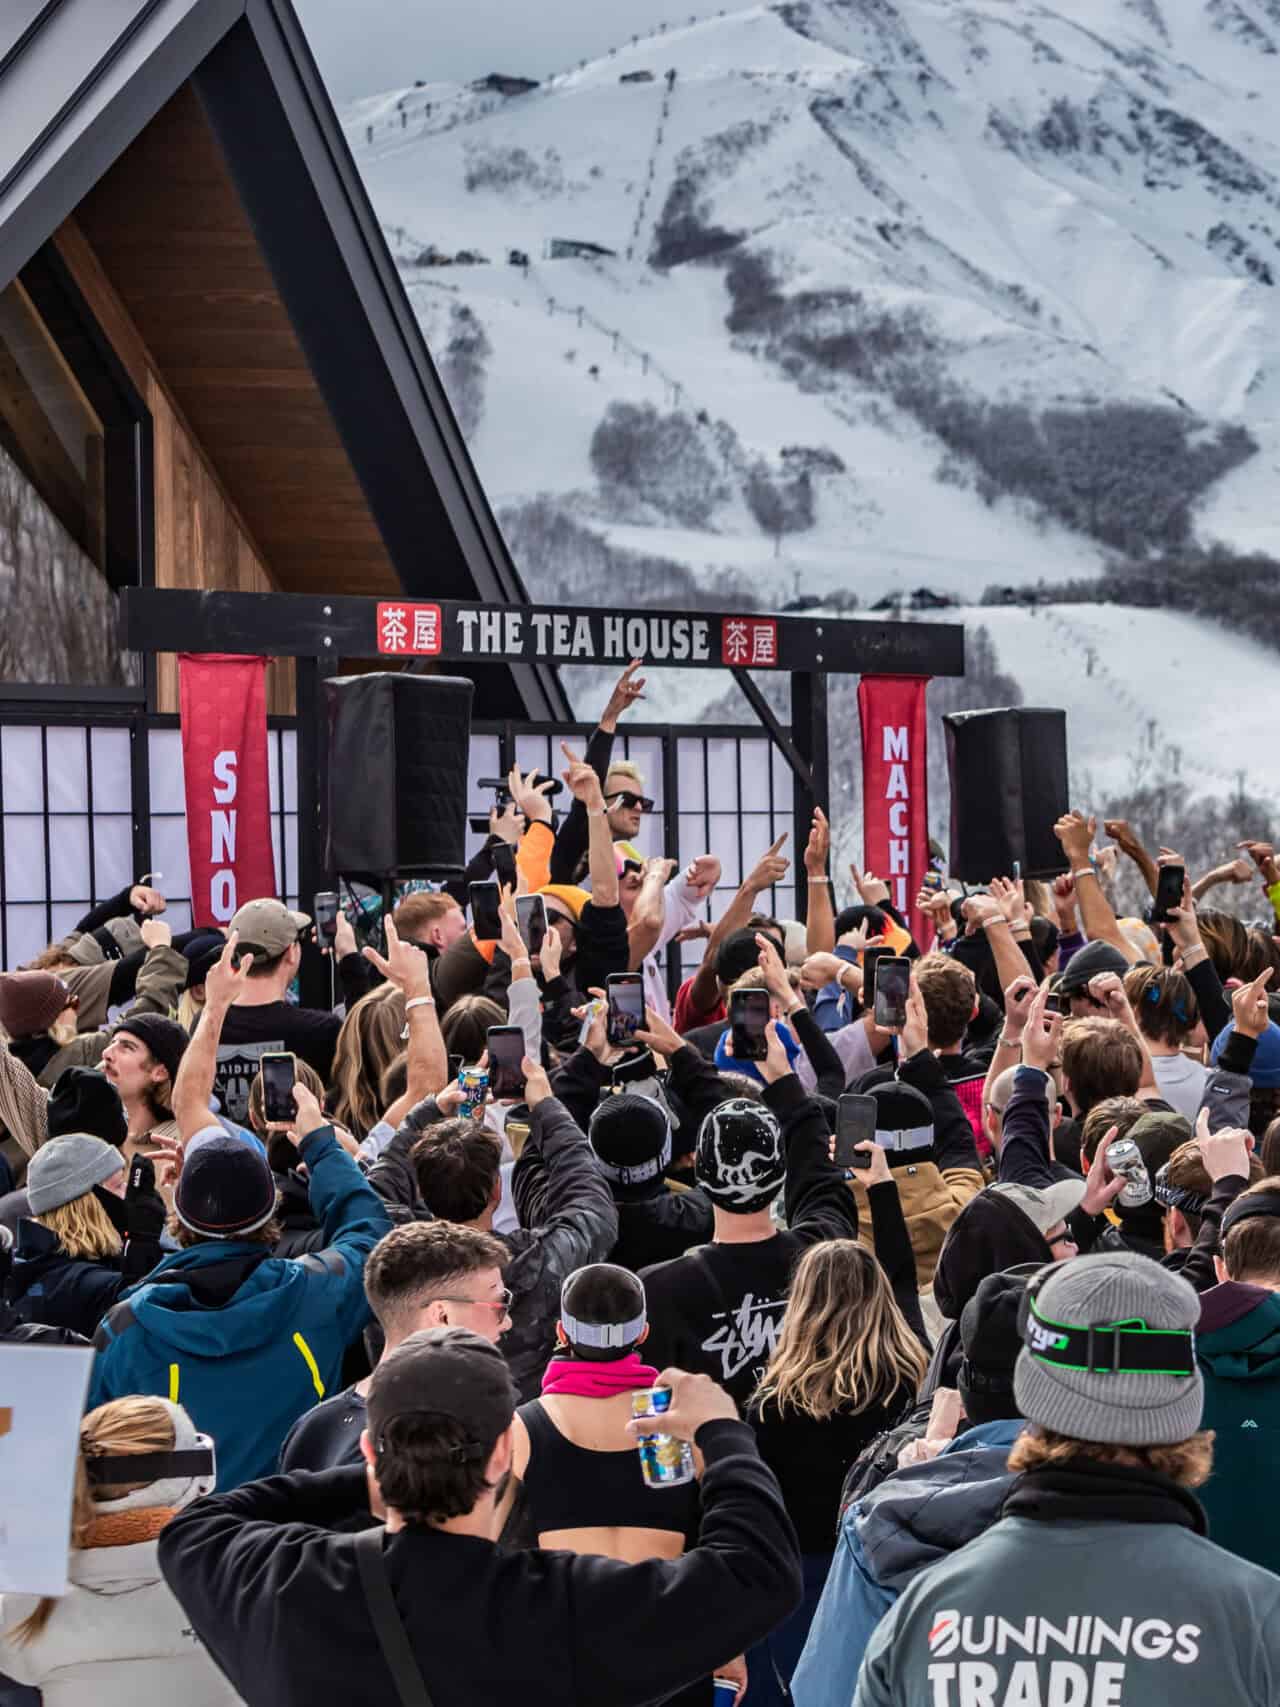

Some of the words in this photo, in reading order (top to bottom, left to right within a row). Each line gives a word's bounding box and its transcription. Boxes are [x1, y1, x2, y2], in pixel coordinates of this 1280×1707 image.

[381, 607, 437, 651] 茶屋
[457, 608, 523, 654] THE
[531, 612, 595, 657] TEA
[603, 616, 710, 660] HOUSE
[725, 621, 776, 665] 茶屋
[210, 750, 238, 922] SNO
[882, 725, 910, 926] MACHI
[219, 1063, 260, 1075] AIDER
[928, 1609, 1202, 1664] BUNNINGS
[927, 1660, 1126, 1707] TRADE
